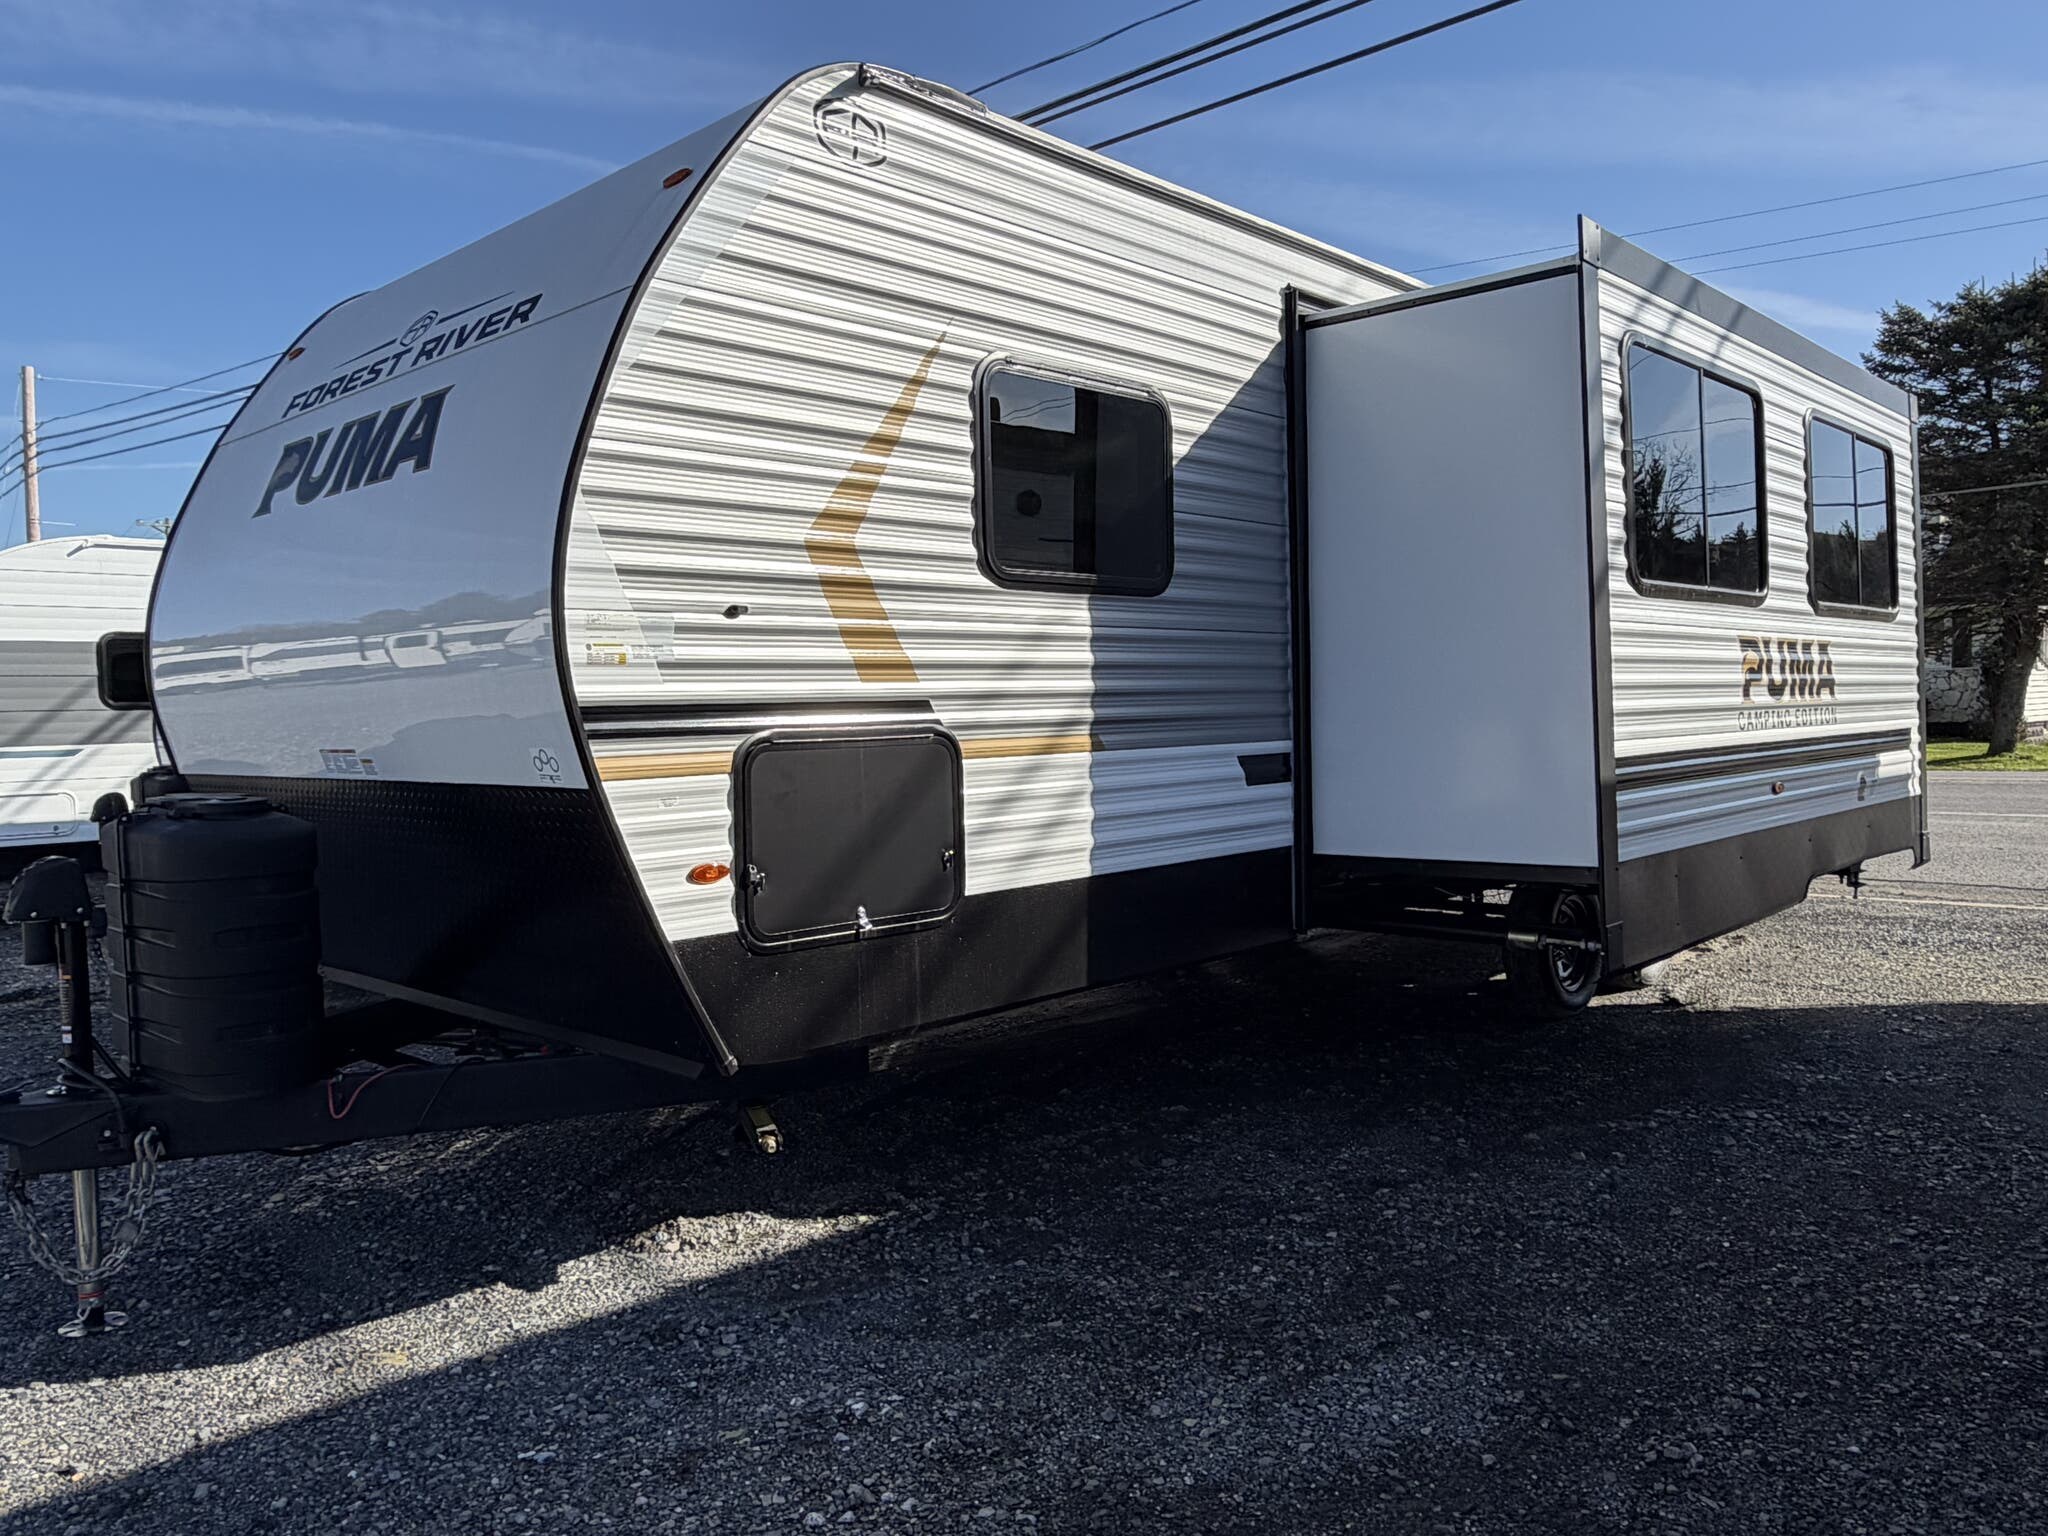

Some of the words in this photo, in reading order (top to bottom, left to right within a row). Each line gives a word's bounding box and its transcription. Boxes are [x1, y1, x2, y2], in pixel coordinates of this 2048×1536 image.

[282, 347, 414, 418] FOREST
[410, 293, 543, 367] RIVER
[252, 384, 456, 518] PUMA
[1737, 635, 1838, 704] PUMA
[1737, 709, 1791, 731] CAMPING
[1795, 706, 1837, 727] EDITION
